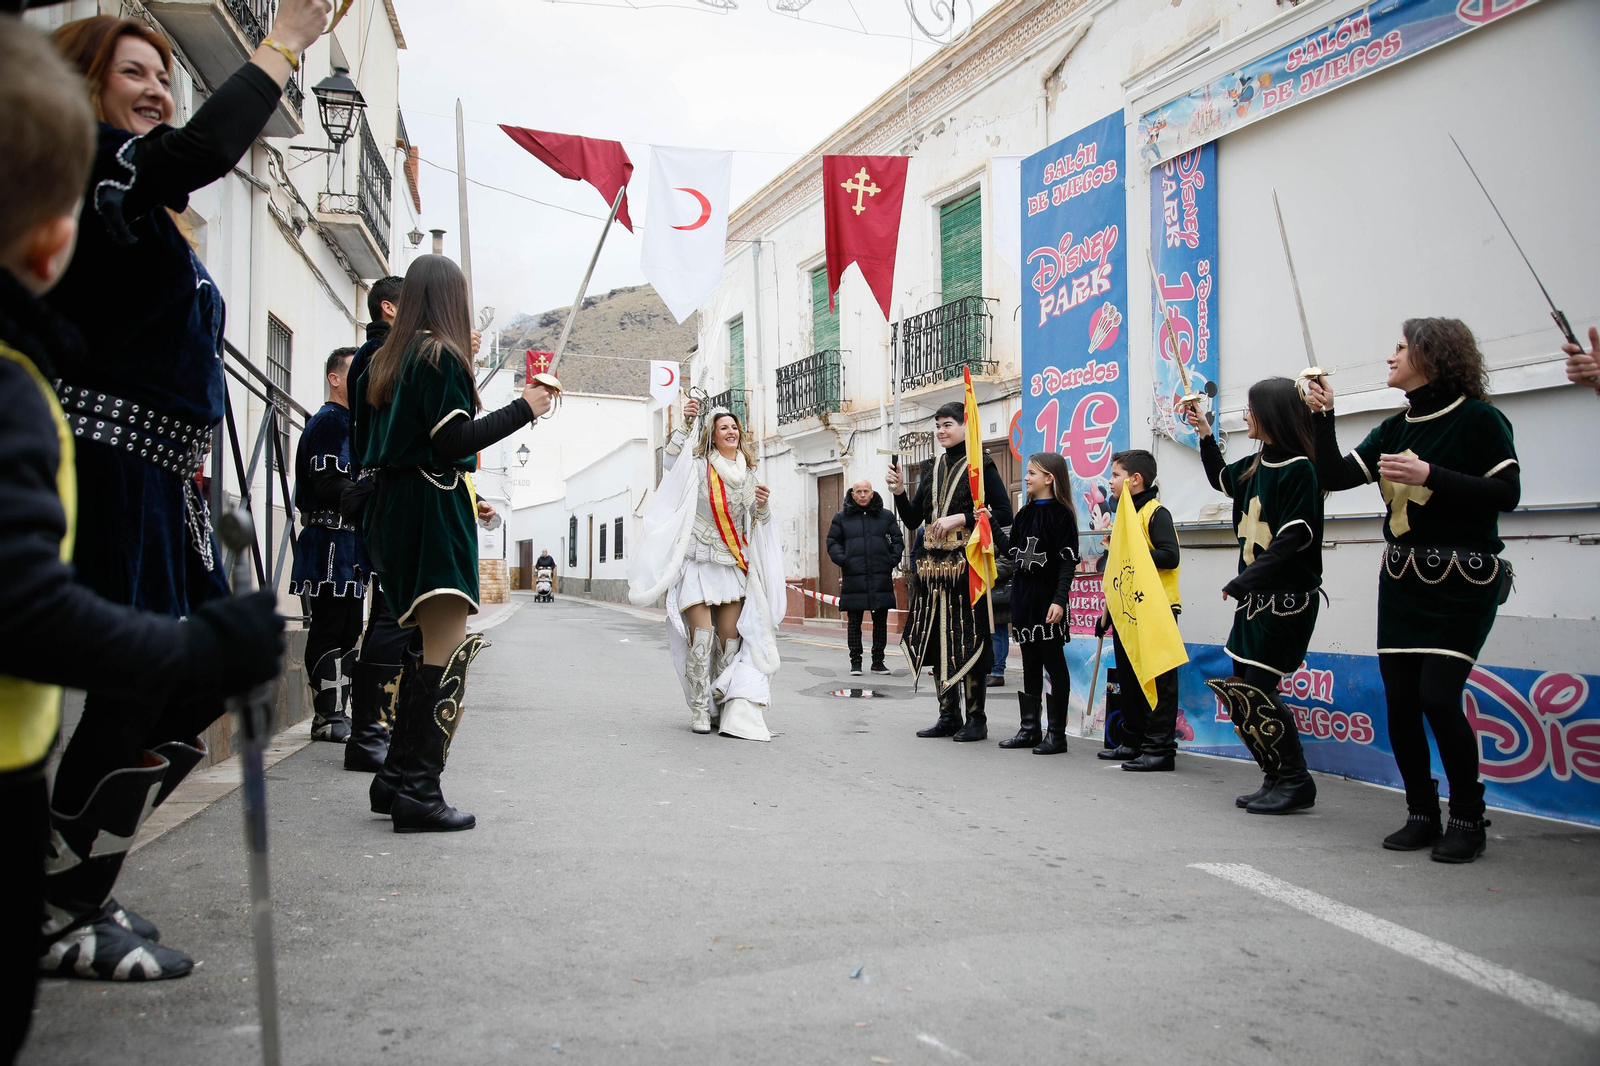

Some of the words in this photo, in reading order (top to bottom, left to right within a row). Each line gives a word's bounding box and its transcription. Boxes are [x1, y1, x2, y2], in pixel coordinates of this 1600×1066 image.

[1261, 79, 1294, 113] DE
[1300, 30, 1402, 94] JUEGOS
[1285, 13, 1371, 72] SALÓN
[1028, 192, 1049, 217] DE
[1052, 160, 1117, 206] JUEGOS
[1044, 142, 1097, 185] SALÓN
[1038, 263, 1113, 328] PARK
[1198, 260, 1209, 276] 3
[1158, 271, 1195, 365] 1€
[1197, 274, 1211, 363] Dardos
[1031, 374, 1043, 397] 3
[1043, 360, 1119, 396] Dardos
[1035, 392, 1119, 479] 1€
[513, 479, 531, 487] CADO
[1288, 704, 1374, 745] EGOS
